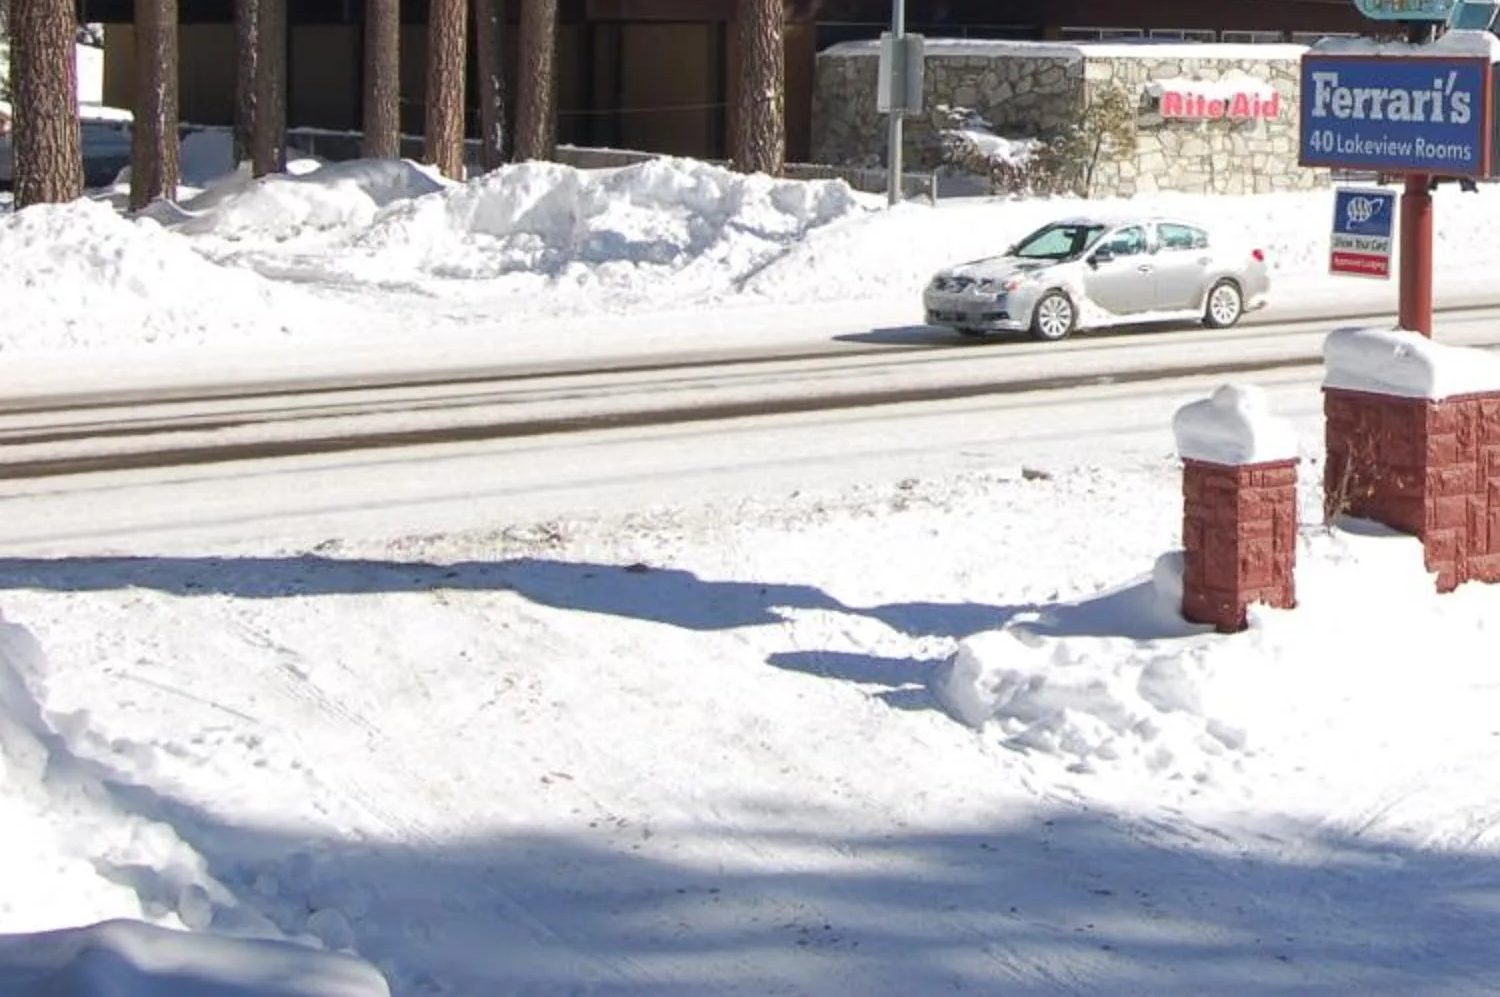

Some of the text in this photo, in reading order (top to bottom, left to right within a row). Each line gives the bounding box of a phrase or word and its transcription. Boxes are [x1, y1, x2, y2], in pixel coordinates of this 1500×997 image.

[1161, 90, 1282, 122] Rite Aid
[1311, 70, 1472, 124] Ferrari's
[1309, 129, 1473, 161] 40 Lakeview Rooms
